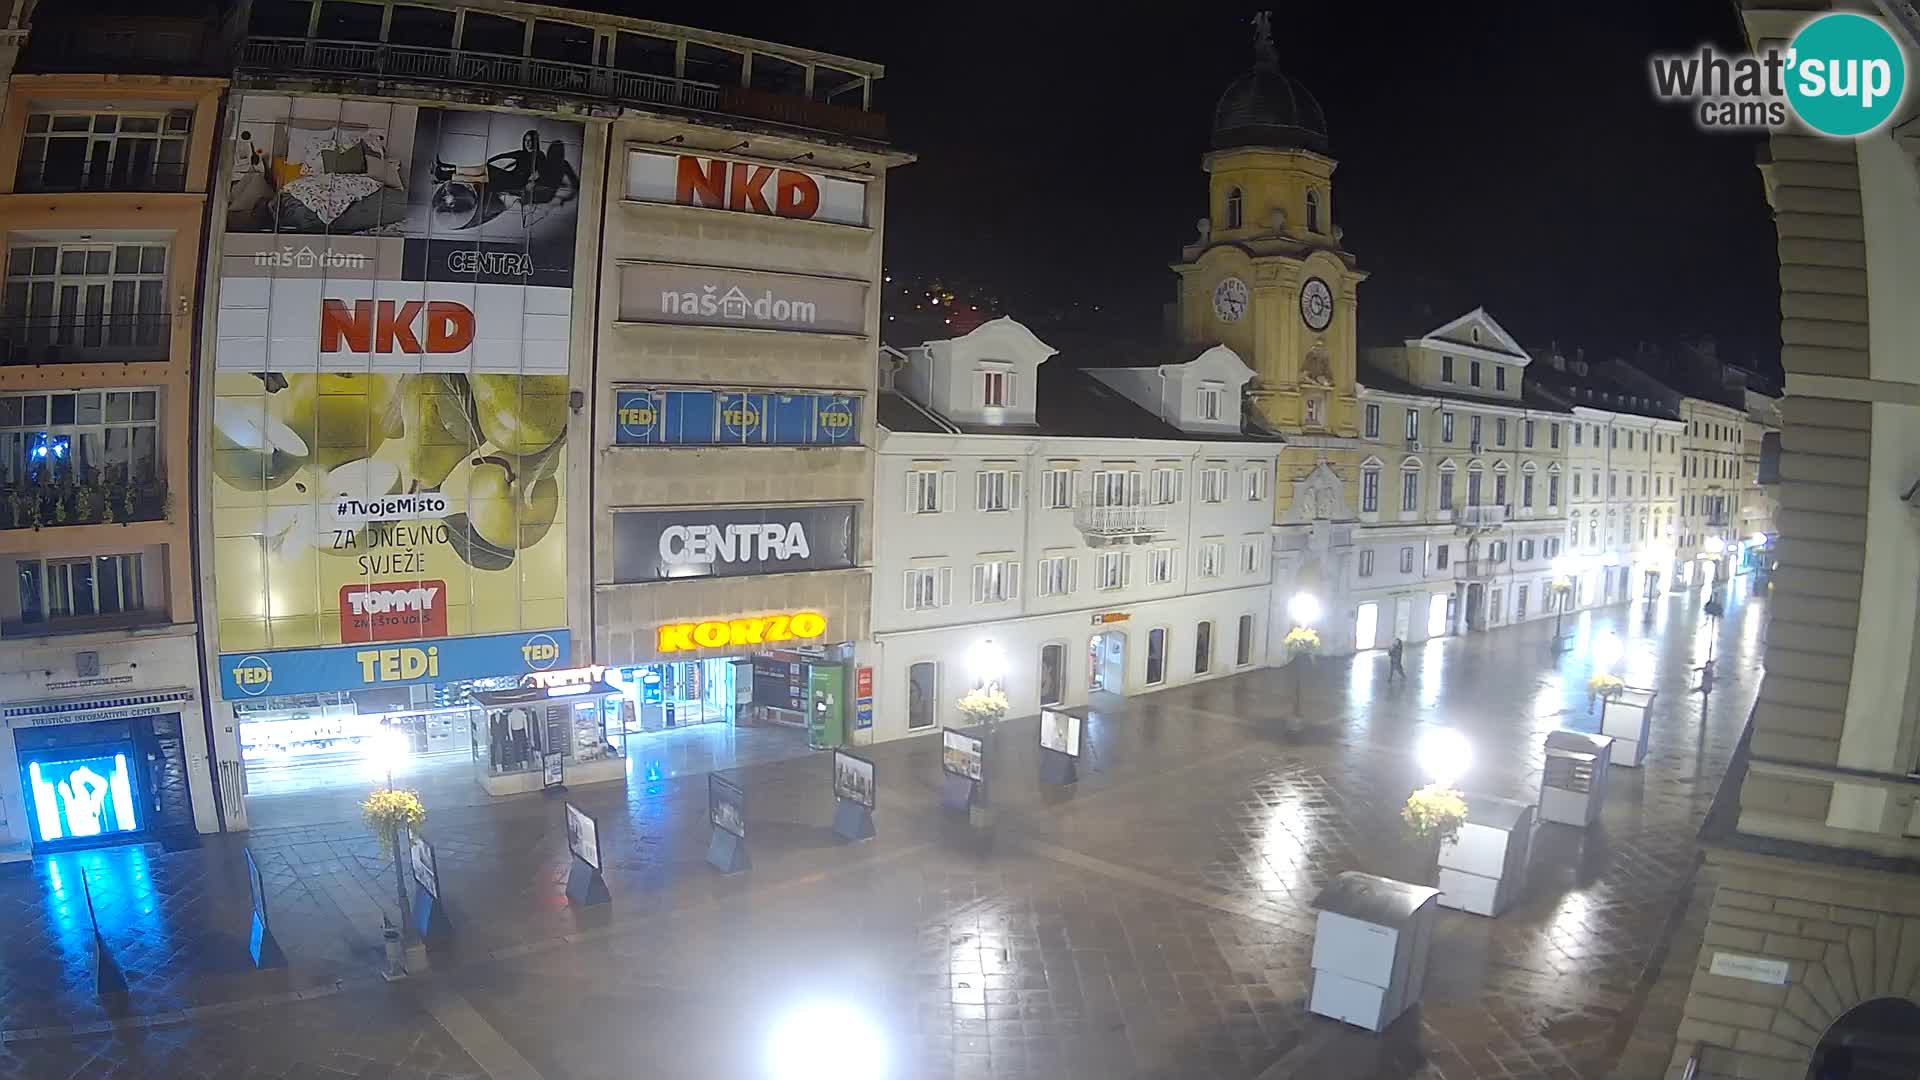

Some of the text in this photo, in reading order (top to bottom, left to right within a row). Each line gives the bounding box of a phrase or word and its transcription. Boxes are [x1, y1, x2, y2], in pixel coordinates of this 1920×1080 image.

[676, 155, 820, 219] NKD
[254, 246, 365, 269] naš dom
[447, 250, 533, 276] CENTRA
[661, 285, 816, 323] naš dom
[320, 299, 476, 353] NKD
[618, 409, 657, 426] TEDi
[333, 525, 449, 550] ZA DNEVNO
[658, 522, 810, 563] CENTRA
[359, 548, 425, 575] SVJEŽE
[348, 588, 438, 615] TOMMY
[658, 613, 825, 652] KORZO
[356, 647, 439, 683] TEDi
[521, 643, 560, 662] TEDi
[232, 665, 273, 685] TEDi
